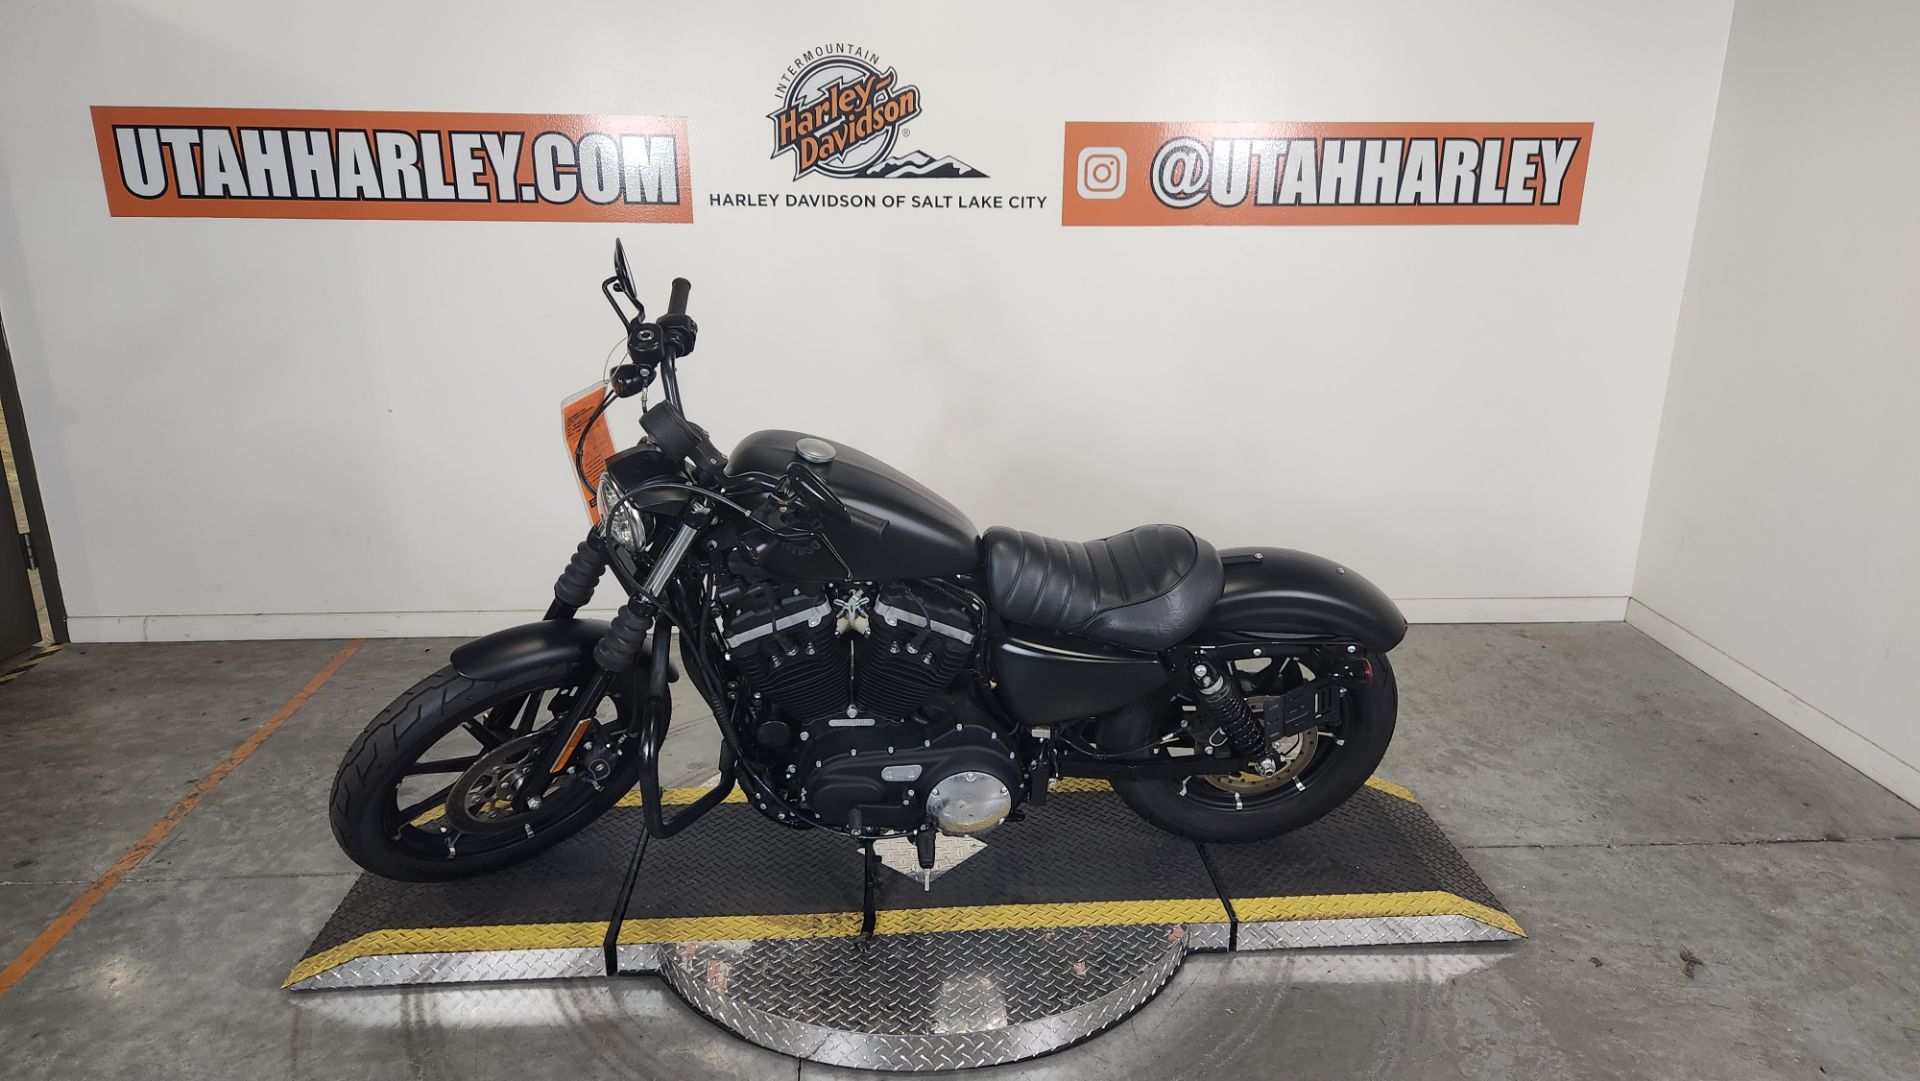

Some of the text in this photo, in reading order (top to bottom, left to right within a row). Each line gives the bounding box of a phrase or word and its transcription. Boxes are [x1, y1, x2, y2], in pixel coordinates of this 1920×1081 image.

[774, 42, 880, 99] INTERMOUNTAIN
[111, 124, 681, 205] UTAHHARLEY.COM
[800, 90, 915, 170] Davidson
[709, 193, 1048, 209] HARLEY DAVIDSON OF SALT LAKE CITY
[1149, 135, 1582, 210] @UTAHHARLEY
